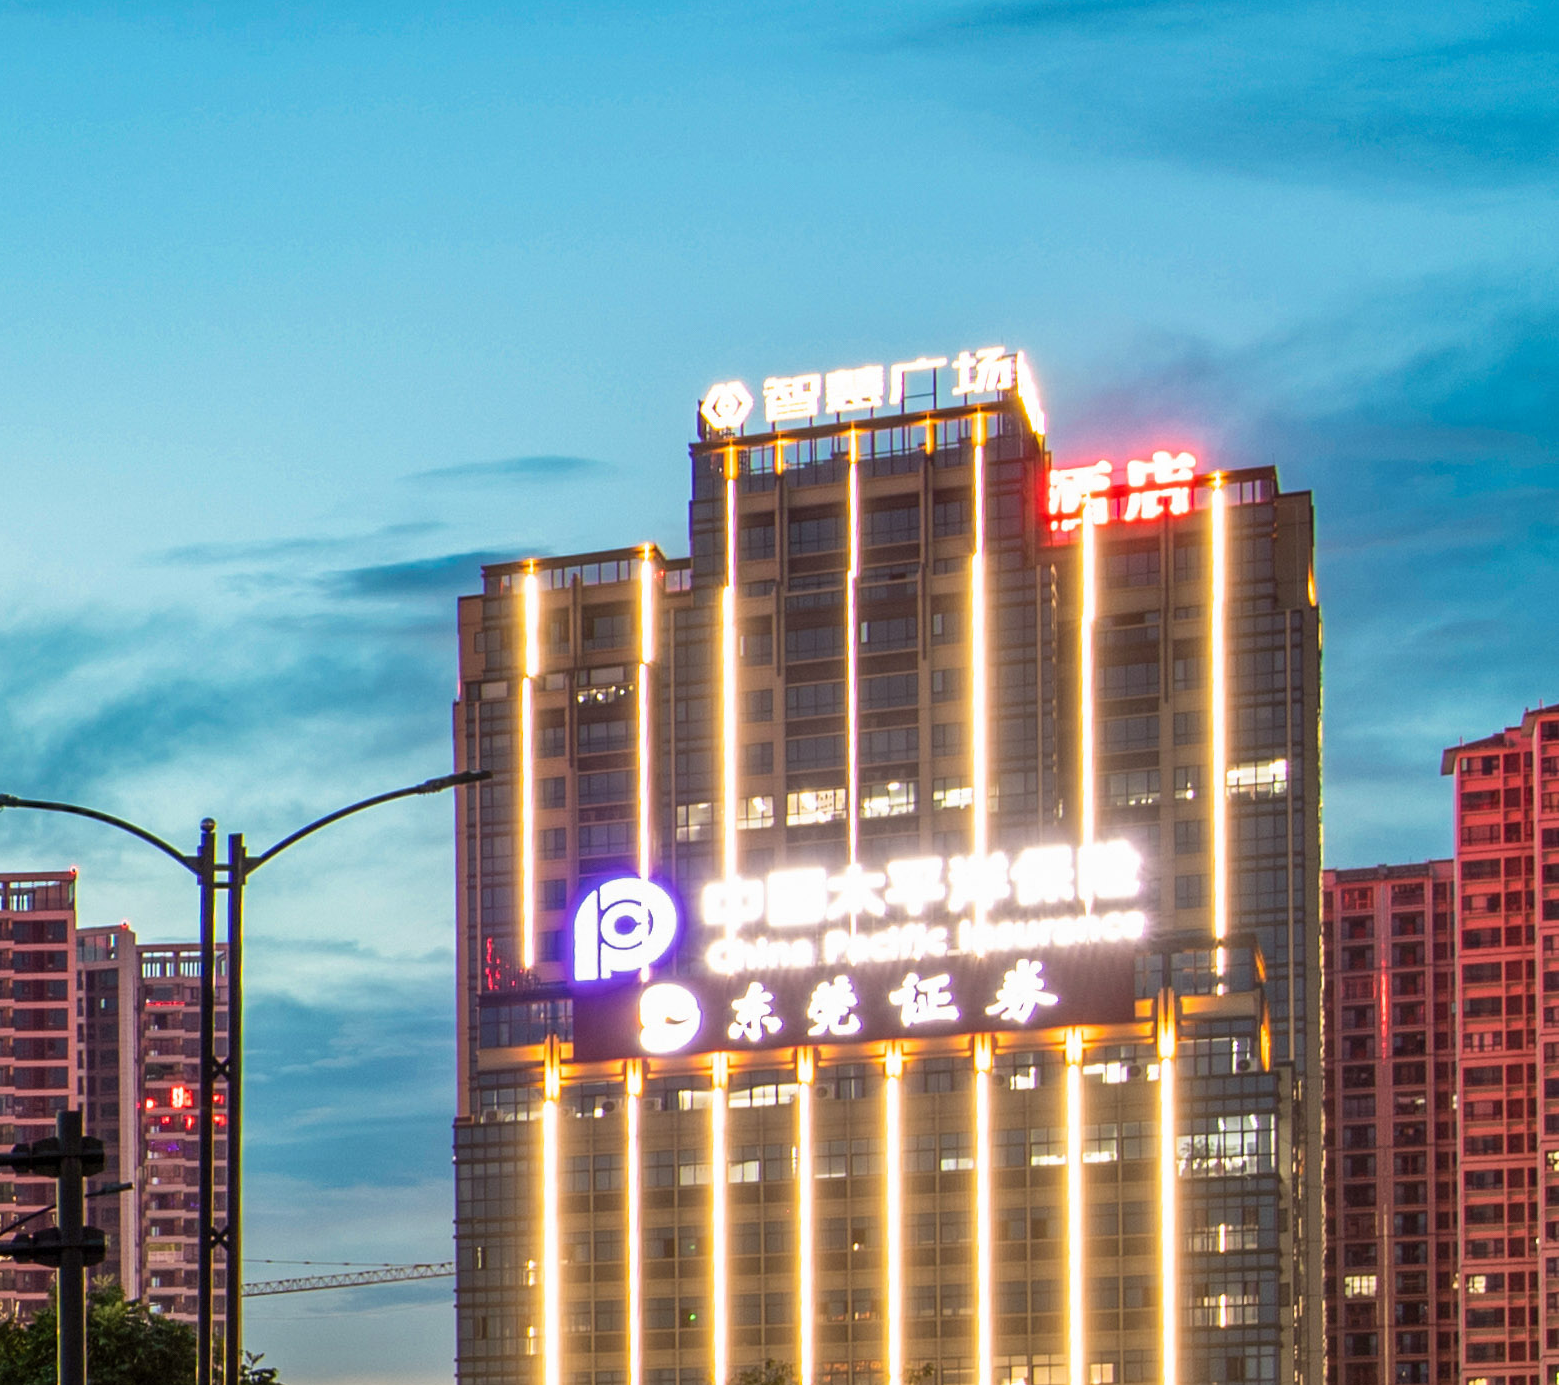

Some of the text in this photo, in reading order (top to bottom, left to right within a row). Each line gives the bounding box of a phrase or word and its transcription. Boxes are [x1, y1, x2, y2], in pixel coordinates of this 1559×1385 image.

[762, 346, 1014, 422] 智慧广场
[706, 912, 1148, 975] China Pacific Insurance
[727, 959, 1059, 1042] 东莞证券
